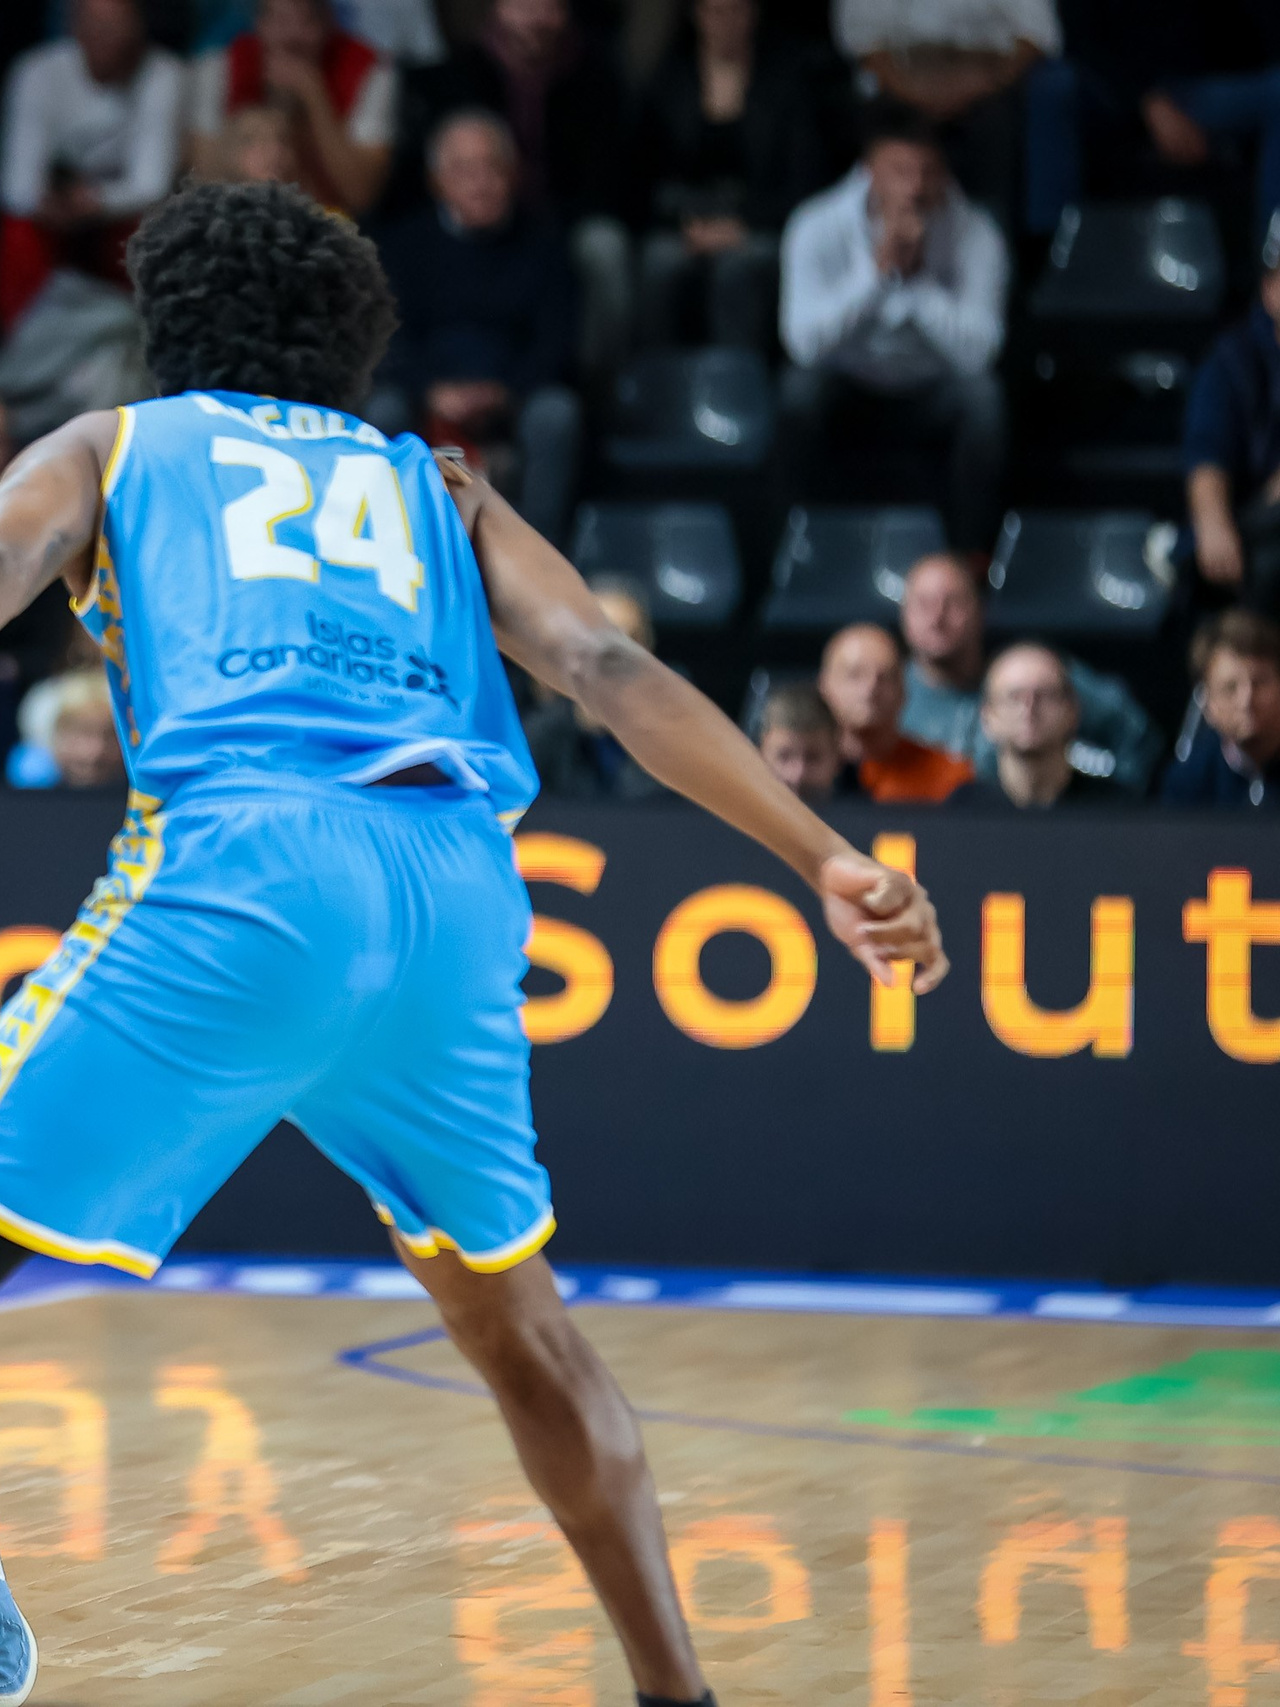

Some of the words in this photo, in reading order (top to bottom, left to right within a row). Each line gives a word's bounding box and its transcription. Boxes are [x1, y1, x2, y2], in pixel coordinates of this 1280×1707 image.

[194, 394, 389, 449] GOLA
[211, 436, 424, 611] 24
[305, 611, 397, 661] Islas
[219, 643, 400, 688] Canarias
